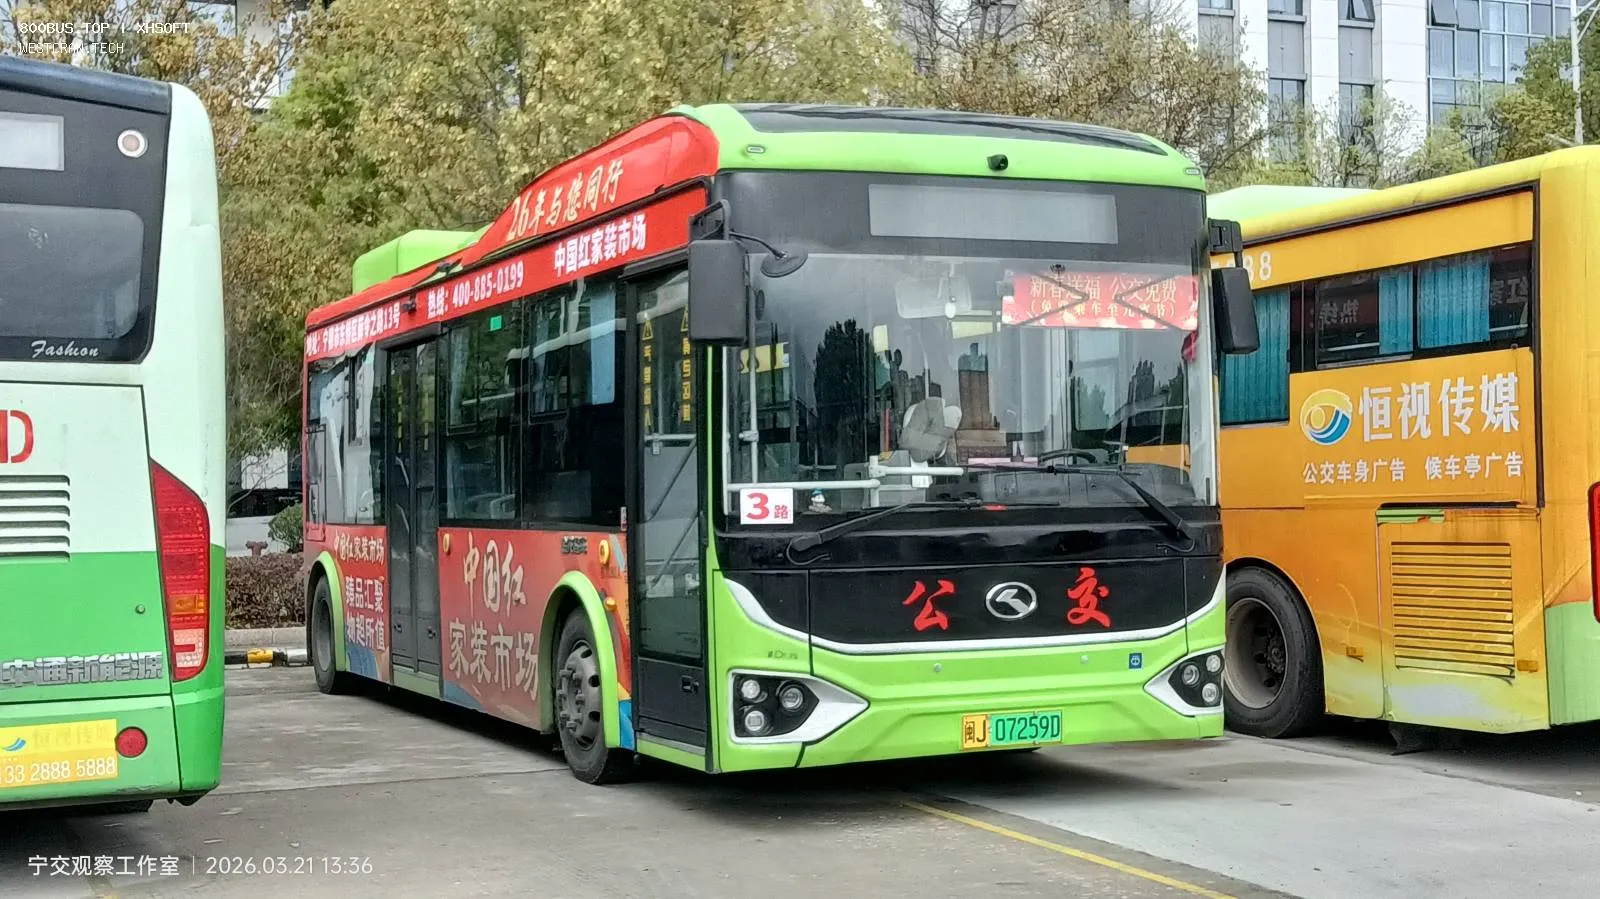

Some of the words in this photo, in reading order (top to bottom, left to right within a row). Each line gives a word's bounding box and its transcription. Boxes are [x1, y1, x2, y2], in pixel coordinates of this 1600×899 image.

[505, 158, 625, 241] 26年与您同行
[553, 213, 647, 278] 中国红家装市场
[1109, 274, 1177, 304] 公交免费
[31, 340, 99, 359] Fashion
[1358, 371, 1521, 443] 恒视传媒
[1302, 456, 1407, 485] 公交车身广告
[1424, 450, 1524, 481] 候车亭广告
[333, 527, 385, 566] 中国红家装市场
[463, 531, 527, 620] 中国红
[346, 611, 386, 652] 物超所值
[1, 651, 163, 687] 中通新能源
[449, 616, 539, 701] 家装市场
[963, 714, 988, 745] 闽J
[994, 713, 1061, 742] 07259D
[30, 760, 71, 782] 2888
[76, 755, 117, 777] 5888
